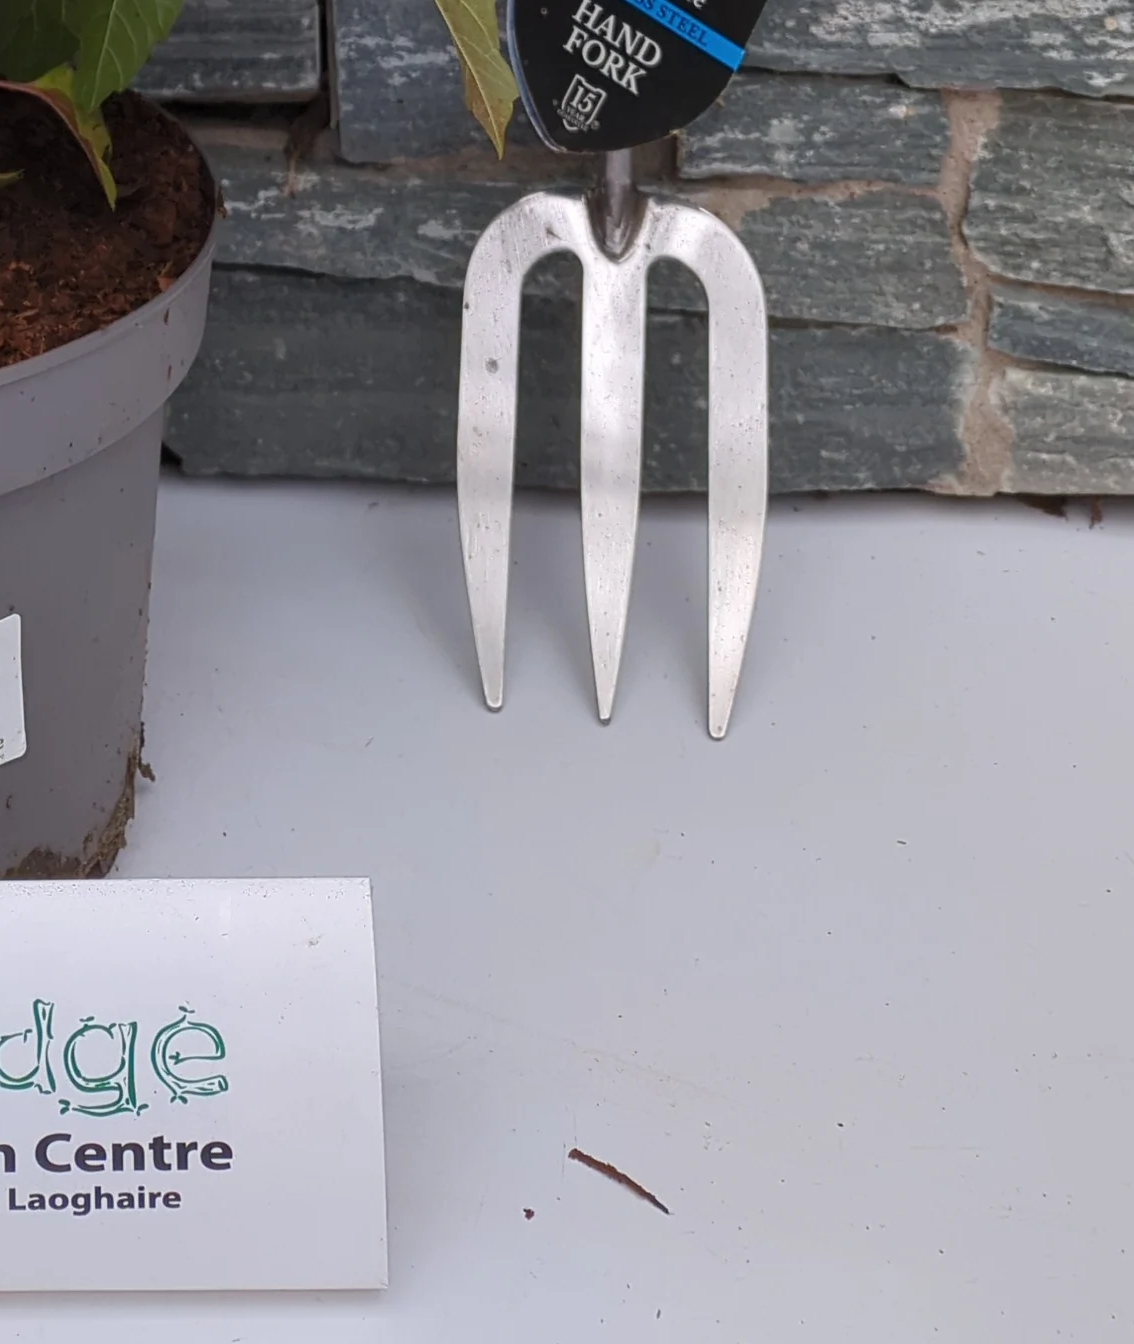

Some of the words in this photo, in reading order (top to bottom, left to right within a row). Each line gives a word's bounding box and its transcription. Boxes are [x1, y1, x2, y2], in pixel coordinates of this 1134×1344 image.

[656, 4, 708, 47] STEEL
[562, 25, 647, 96] FORK
[569, 85, 597, 112] 15
[34, 1133, 234, 1172] Centre
[9, 1186, 182, 1216] Laoghaire
